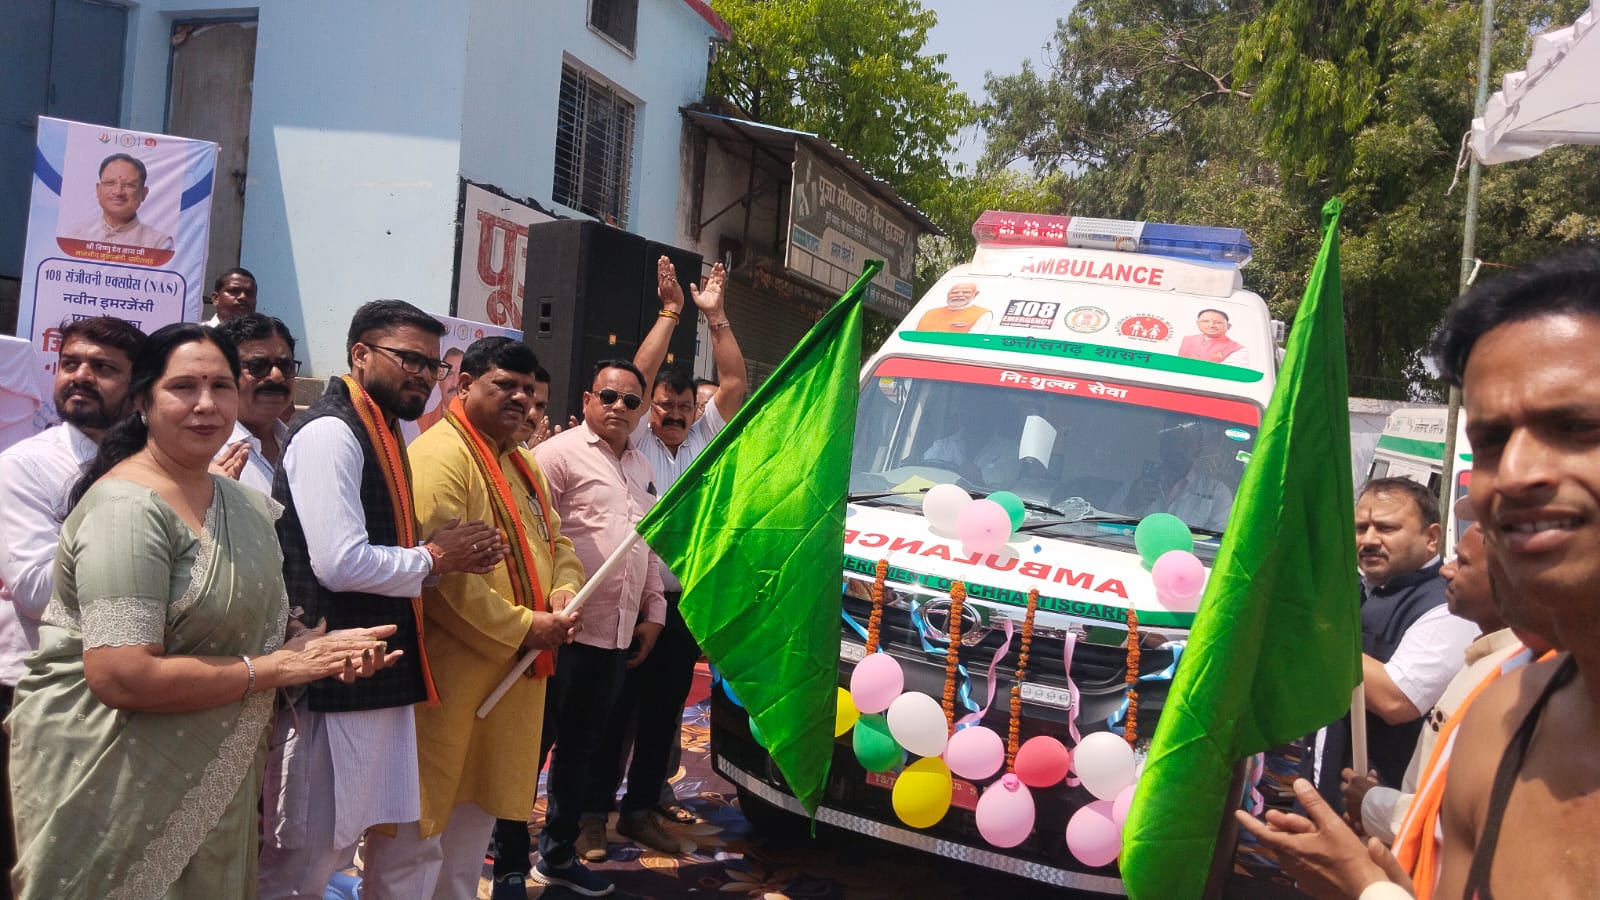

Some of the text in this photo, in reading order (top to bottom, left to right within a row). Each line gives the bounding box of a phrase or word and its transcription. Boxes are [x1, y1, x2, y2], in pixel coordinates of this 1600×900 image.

[1020, 256, 1164, 286] AMBULANCE
[45, 268, 62, 281] 108
[65, 268, 101, 286] संजीवनी
[144, 278, 178, 296] (NAS)
[63, 292, 97, 306] नवीन
[1012, 301, 1056, 318] 108
[1094, 346, 1152, 363] शासन
[1087, 381, 1129, 398] सेवा
